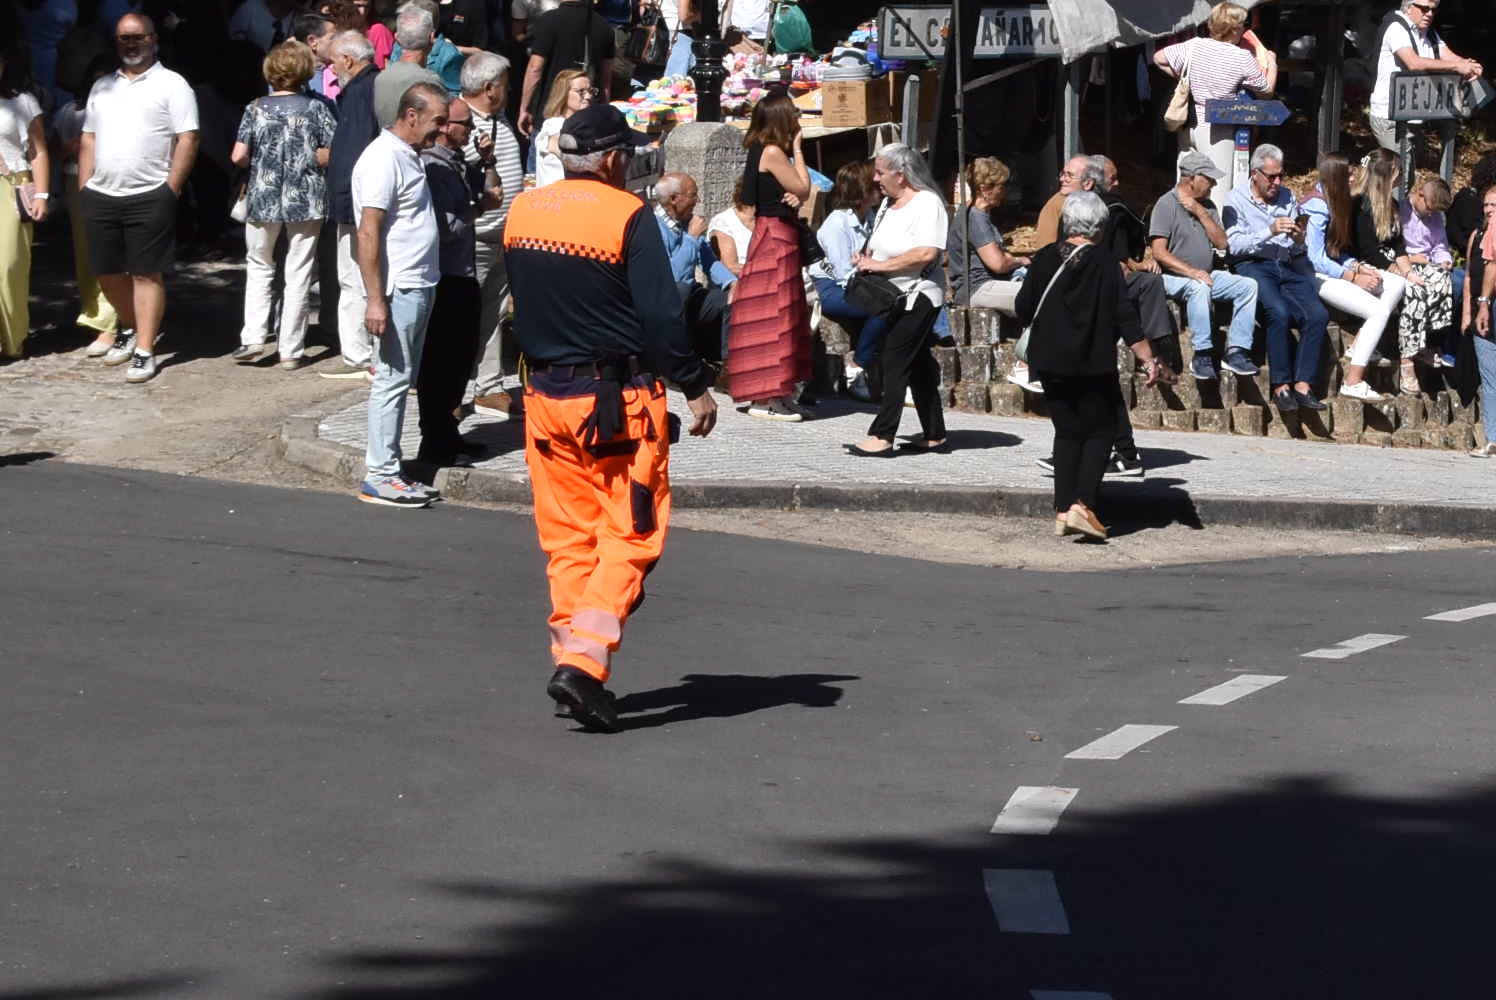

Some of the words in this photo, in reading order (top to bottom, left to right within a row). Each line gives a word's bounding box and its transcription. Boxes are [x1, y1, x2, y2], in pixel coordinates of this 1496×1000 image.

[890, 15, 916, 47] EL
[927, 10, 1033, 47] CAÑAR
[1399, 78, 1455, 113] BÉJAR
